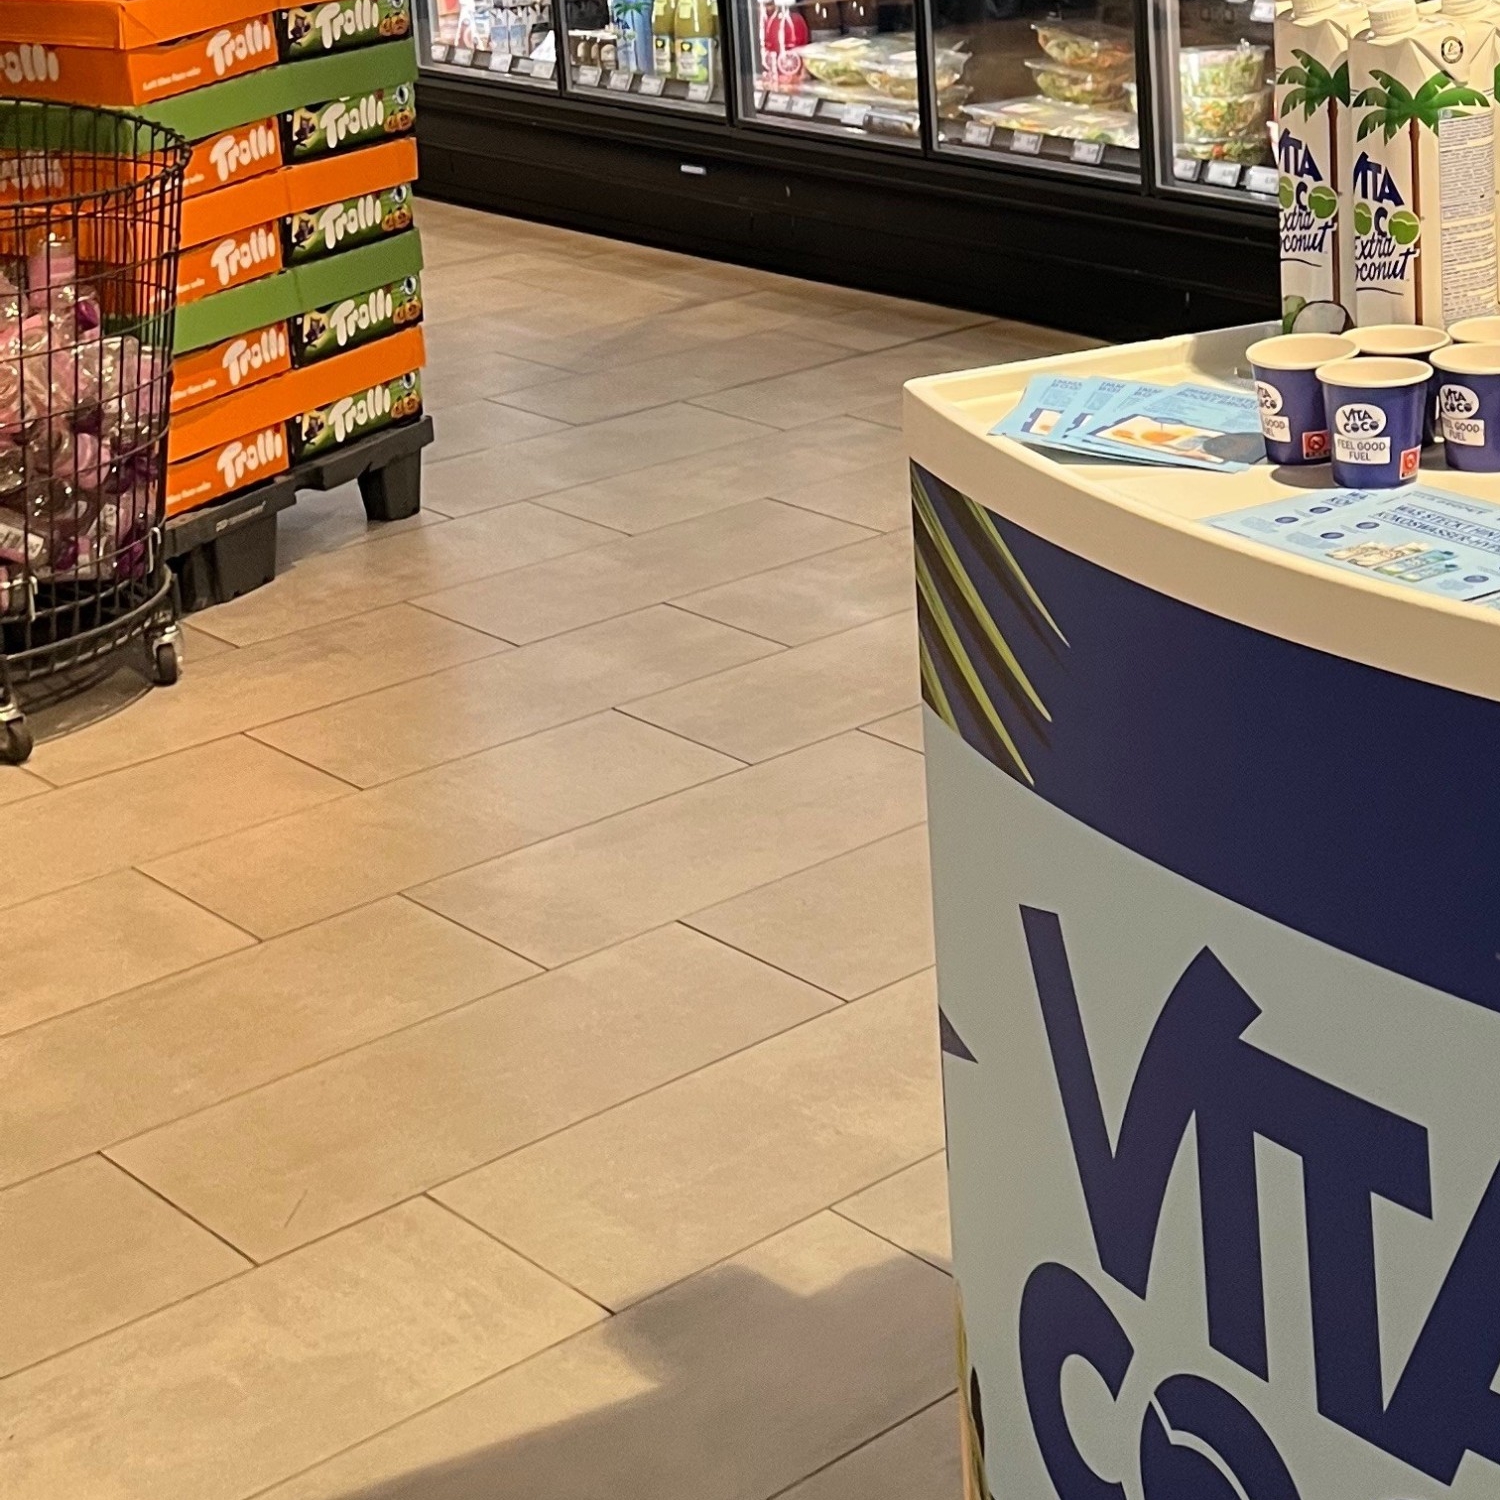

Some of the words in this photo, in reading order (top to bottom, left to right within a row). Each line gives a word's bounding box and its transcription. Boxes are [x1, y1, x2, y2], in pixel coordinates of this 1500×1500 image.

[206, 19, 271, 76] Trolli
[320, 94, 384, 149] Trolli
[210, 125, 275, 182] Trolli
[318, 194, 382, 250] Trolli
[211, 227, 276, 286] Trolli
[330, 288, 393, 347] Trolli
[222, 327, 285, 387] Trolli
[328, 384, 391, 443] Trolli
[1342, 407, 1373, 422] VITA
[1443, 387, 1466, 402] VITA
[1443, 400, 1473, 413] COCO
[1337, 438, 1356, 451] FEEL
[1356, 440, 1386, 452] GOOD
[1343, 419, 1380, 434] COCO
[1454, 421, 1480, 433] GOOD
[217, 429, 283, 489] Trolli
[1348, 450, 1372, 462] FUEL
